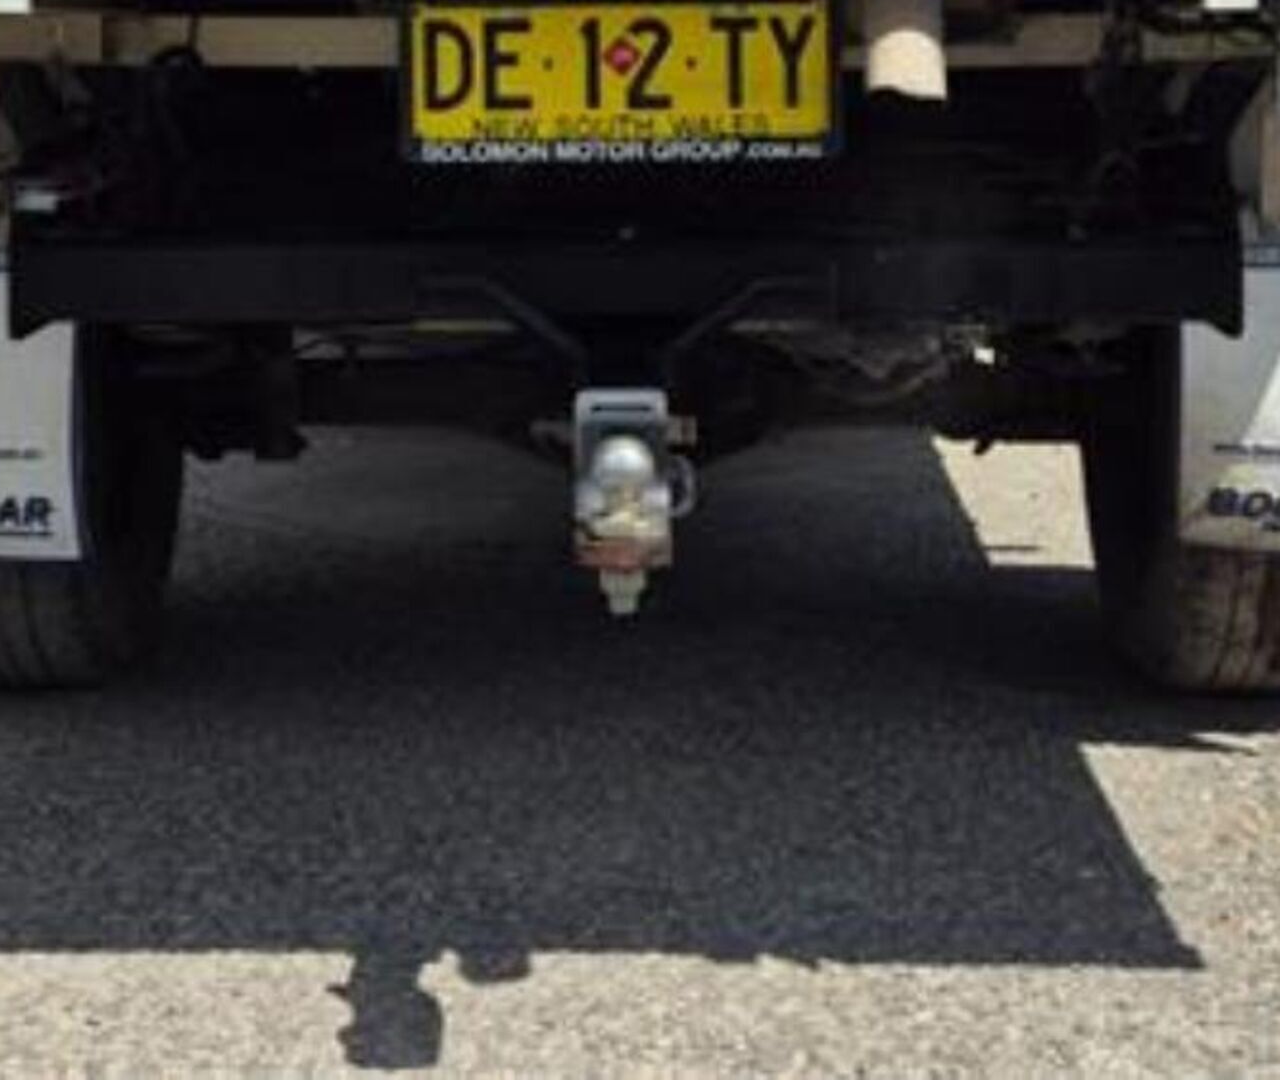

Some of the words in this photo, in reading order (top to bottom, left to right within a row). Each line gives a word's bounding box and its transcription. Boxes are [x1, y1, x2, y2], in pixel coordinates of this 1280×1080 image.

[422, 141, 549, 163] SOLOMON
[554, 141, 645, 162] MOTOR
[650, 140, 741, 162] GROUP
